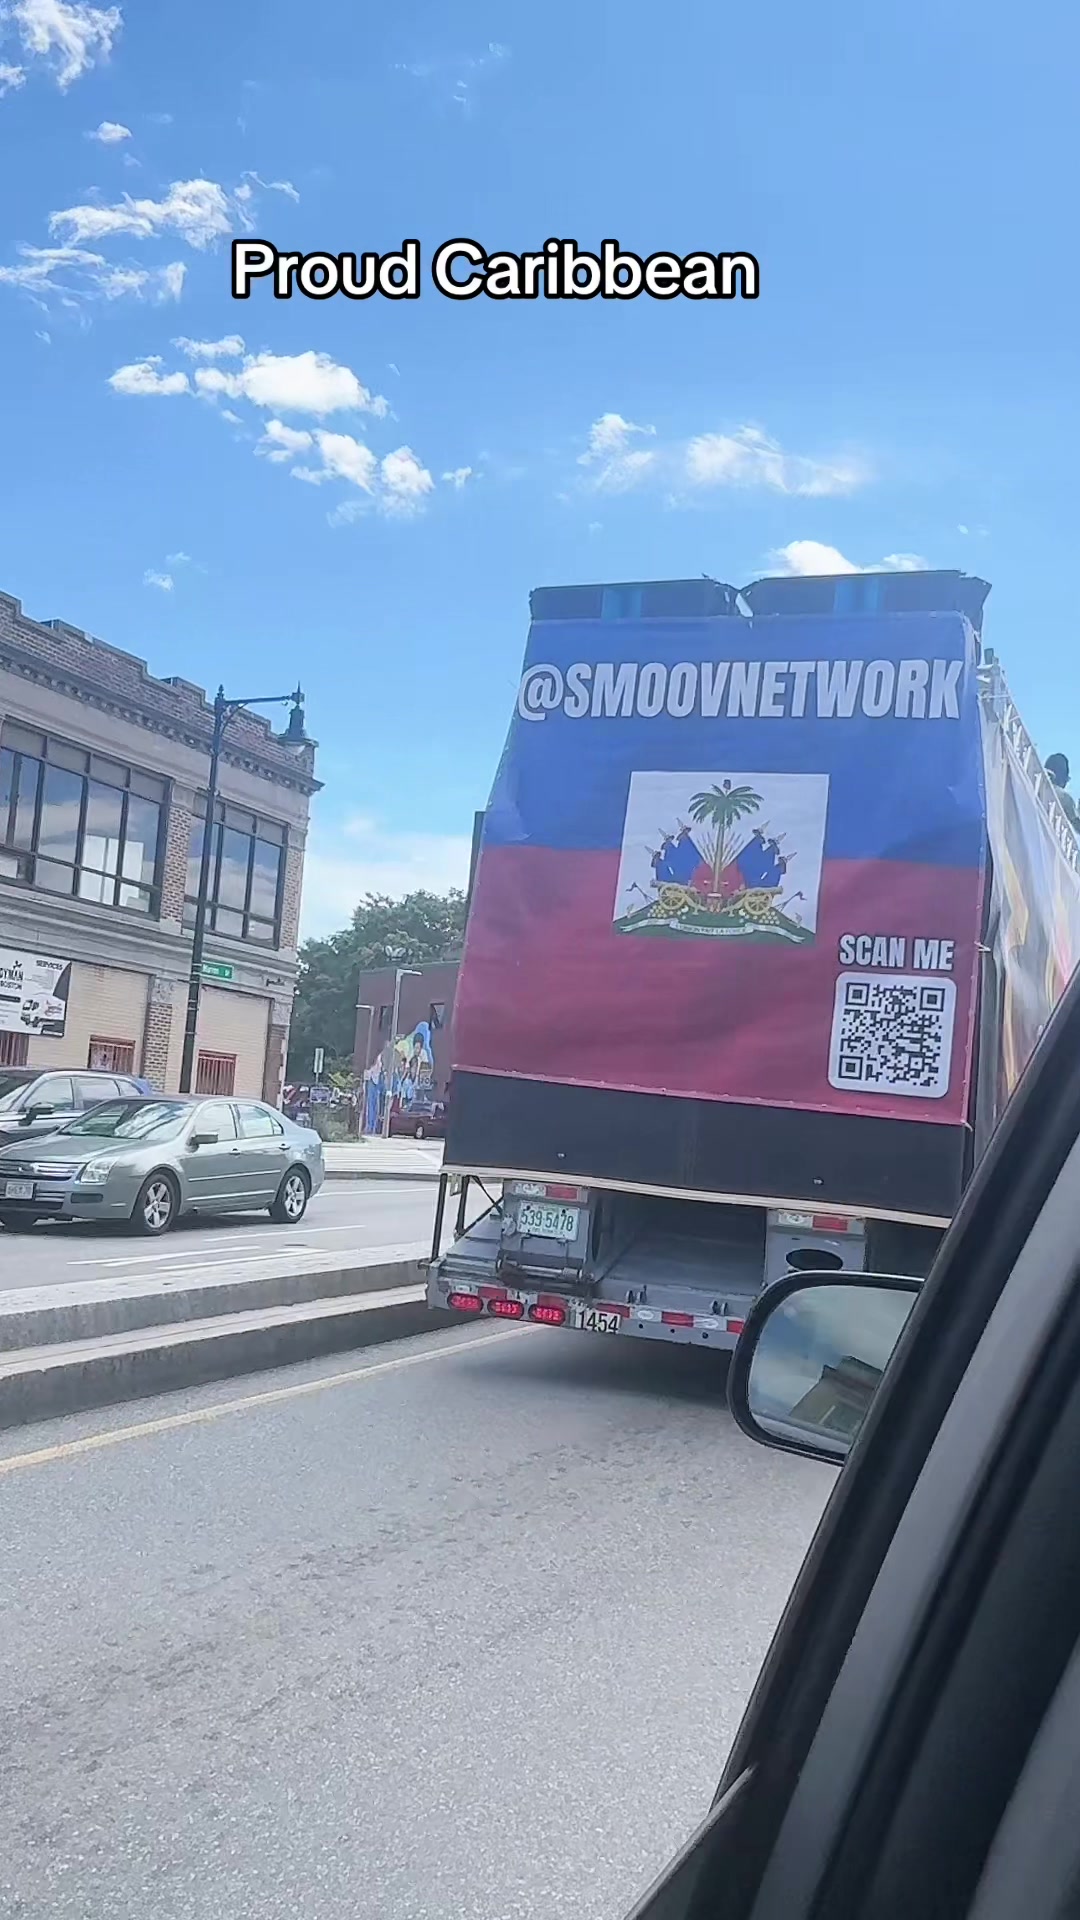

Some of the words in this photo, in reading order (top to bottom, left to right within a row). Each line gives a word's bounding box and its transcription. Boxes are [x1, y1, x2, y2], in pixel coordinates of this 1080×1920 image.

[517, 658, 963, 720] @SMOOVNETWORK
[839, 934, 905, 968] SCAN
[913, 938, 955, 970] ME
[579, 1310, 619, 1334] 1454
